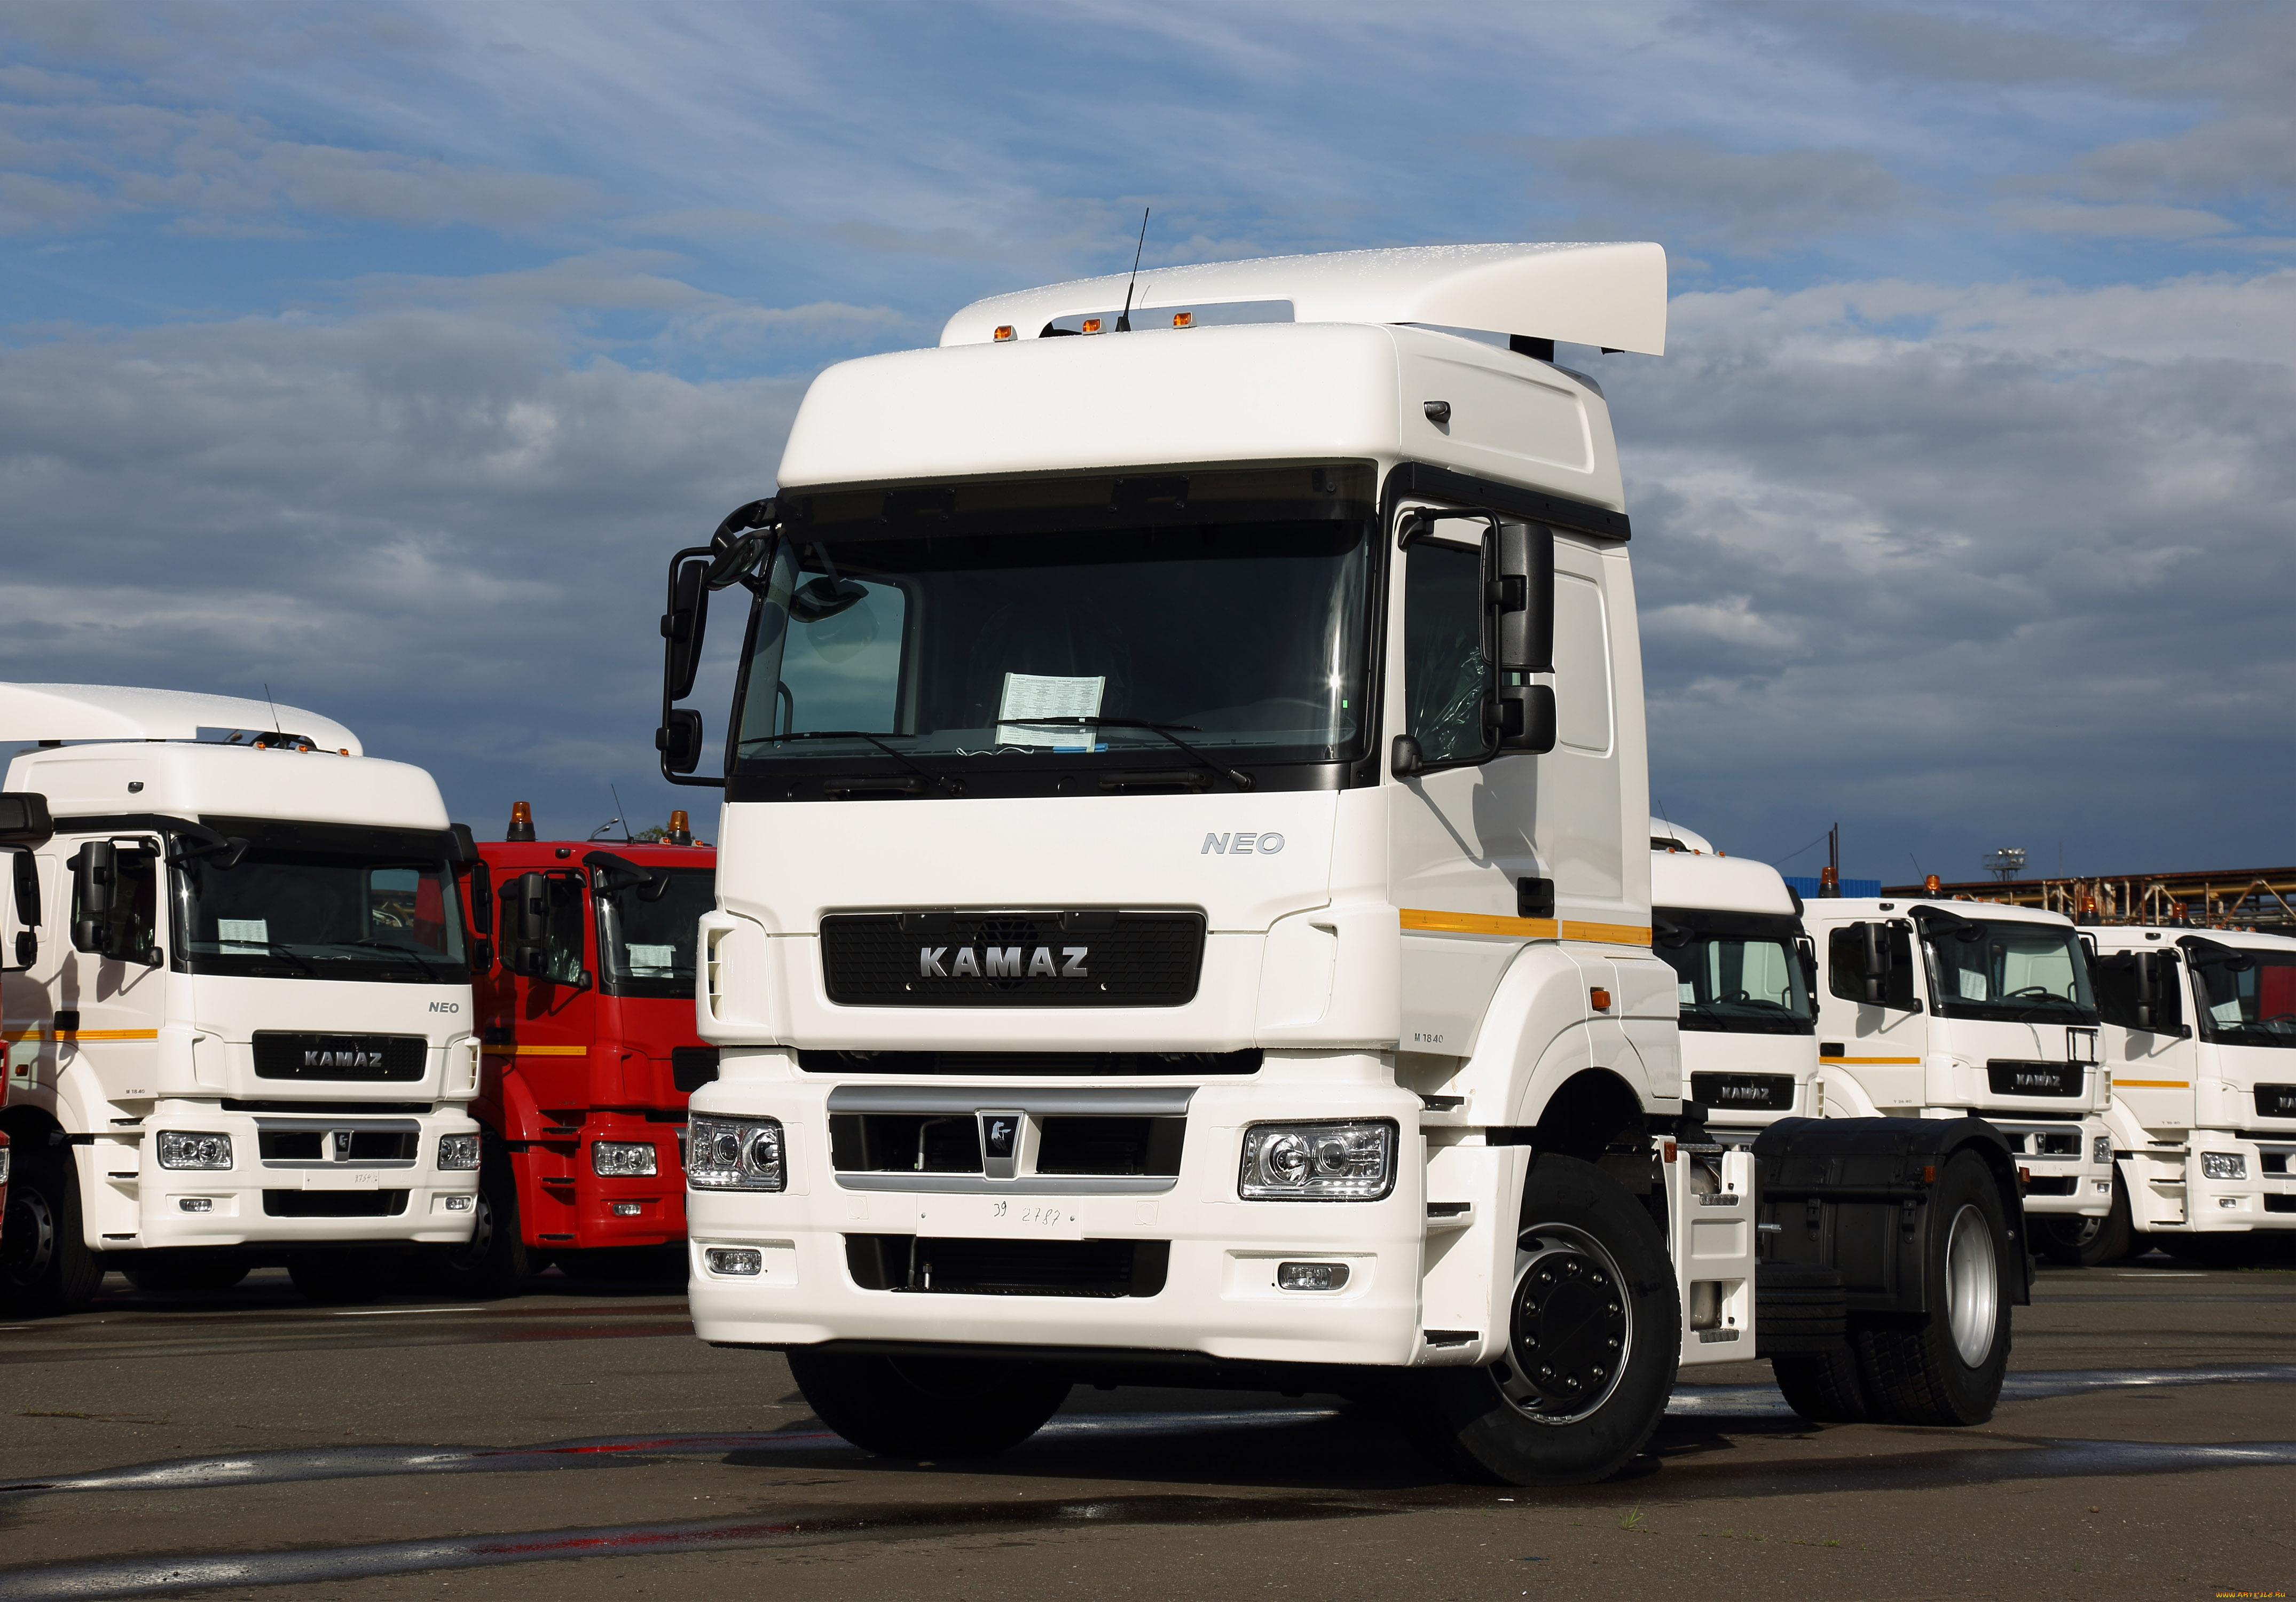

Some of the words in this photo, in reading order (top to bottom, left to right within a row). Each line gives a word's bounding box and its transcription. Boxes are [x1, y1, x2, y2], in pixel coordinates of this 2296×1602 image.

[1200, 833, 1285, 854] NEO
[920, 947, 1088, 977] KAMAZ
[428, 1002, 459, 1014] NEO
[305, 1051, 382, 1067] KAMAZ
[2016, 1074, 2061, 1087] KAMAZ
[1722, 1087, 1769, 1100] KAMAZ
[2279, 1097, 2296, 1108] KA
